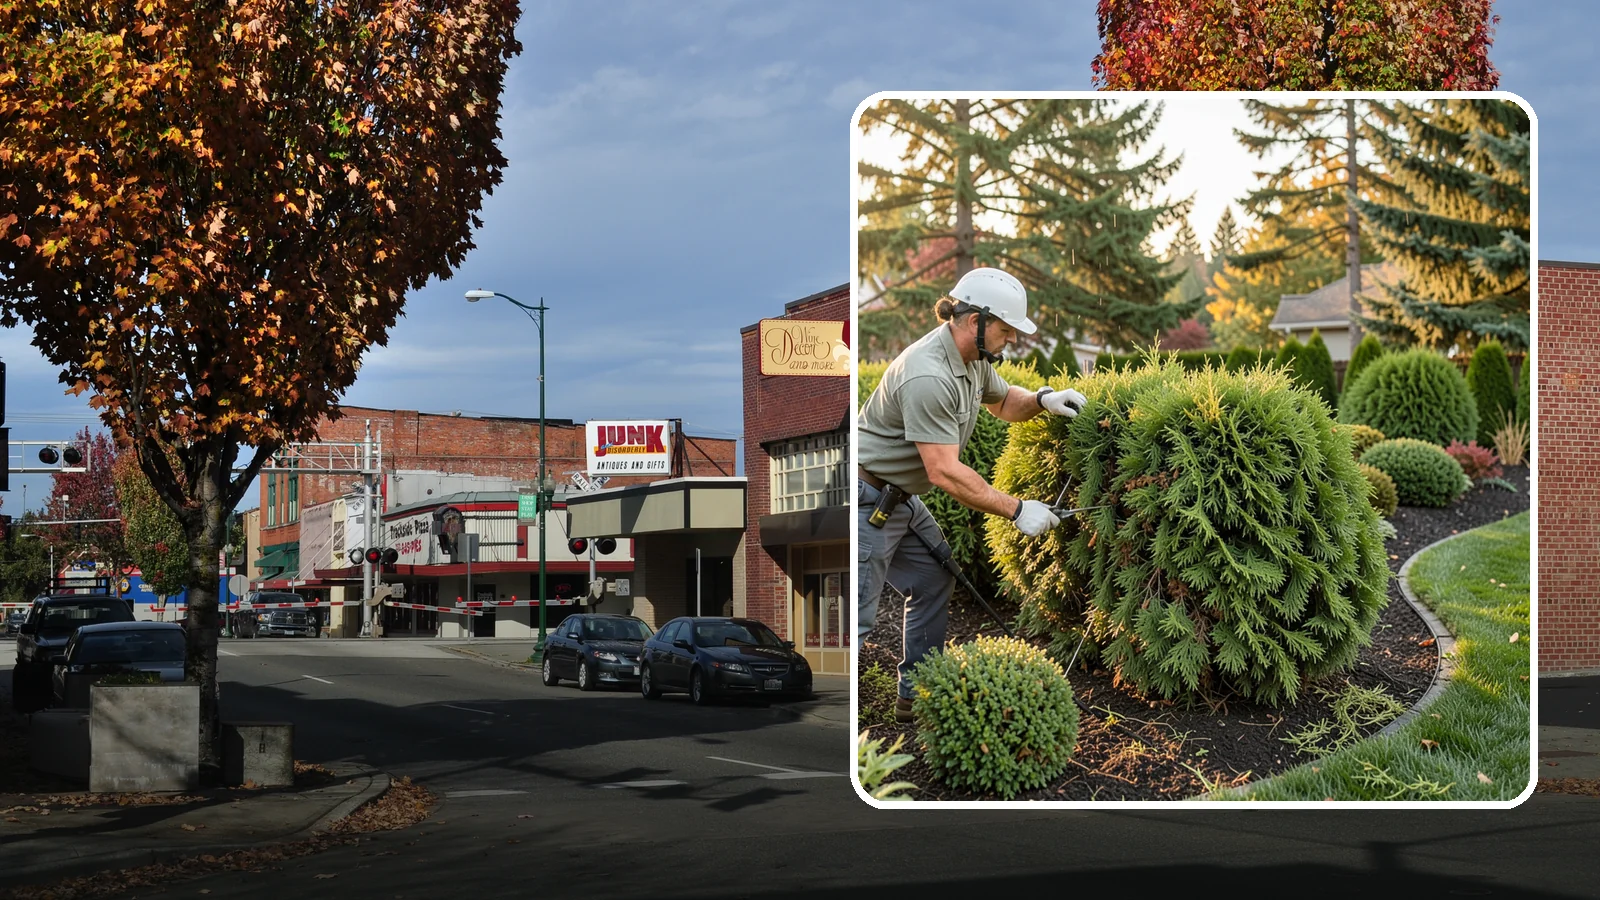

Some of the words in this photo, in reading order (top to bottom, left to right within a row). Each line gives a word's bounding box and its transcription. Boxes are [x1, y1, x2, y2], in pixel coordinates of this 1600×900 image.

[765, 328, 831, 365] Decor
[595, 425, 665, 457] JUNK
[607, 446, 646, 454] DISORDERLY
[597, 461, 628, 470] ANTIQUES
[631, 461, 644, 469] AND
[647, 460, 666, 469] GIFTS
[390, 523, 413, 540] Trackside
[415, 520, 429, 535] Pizza
